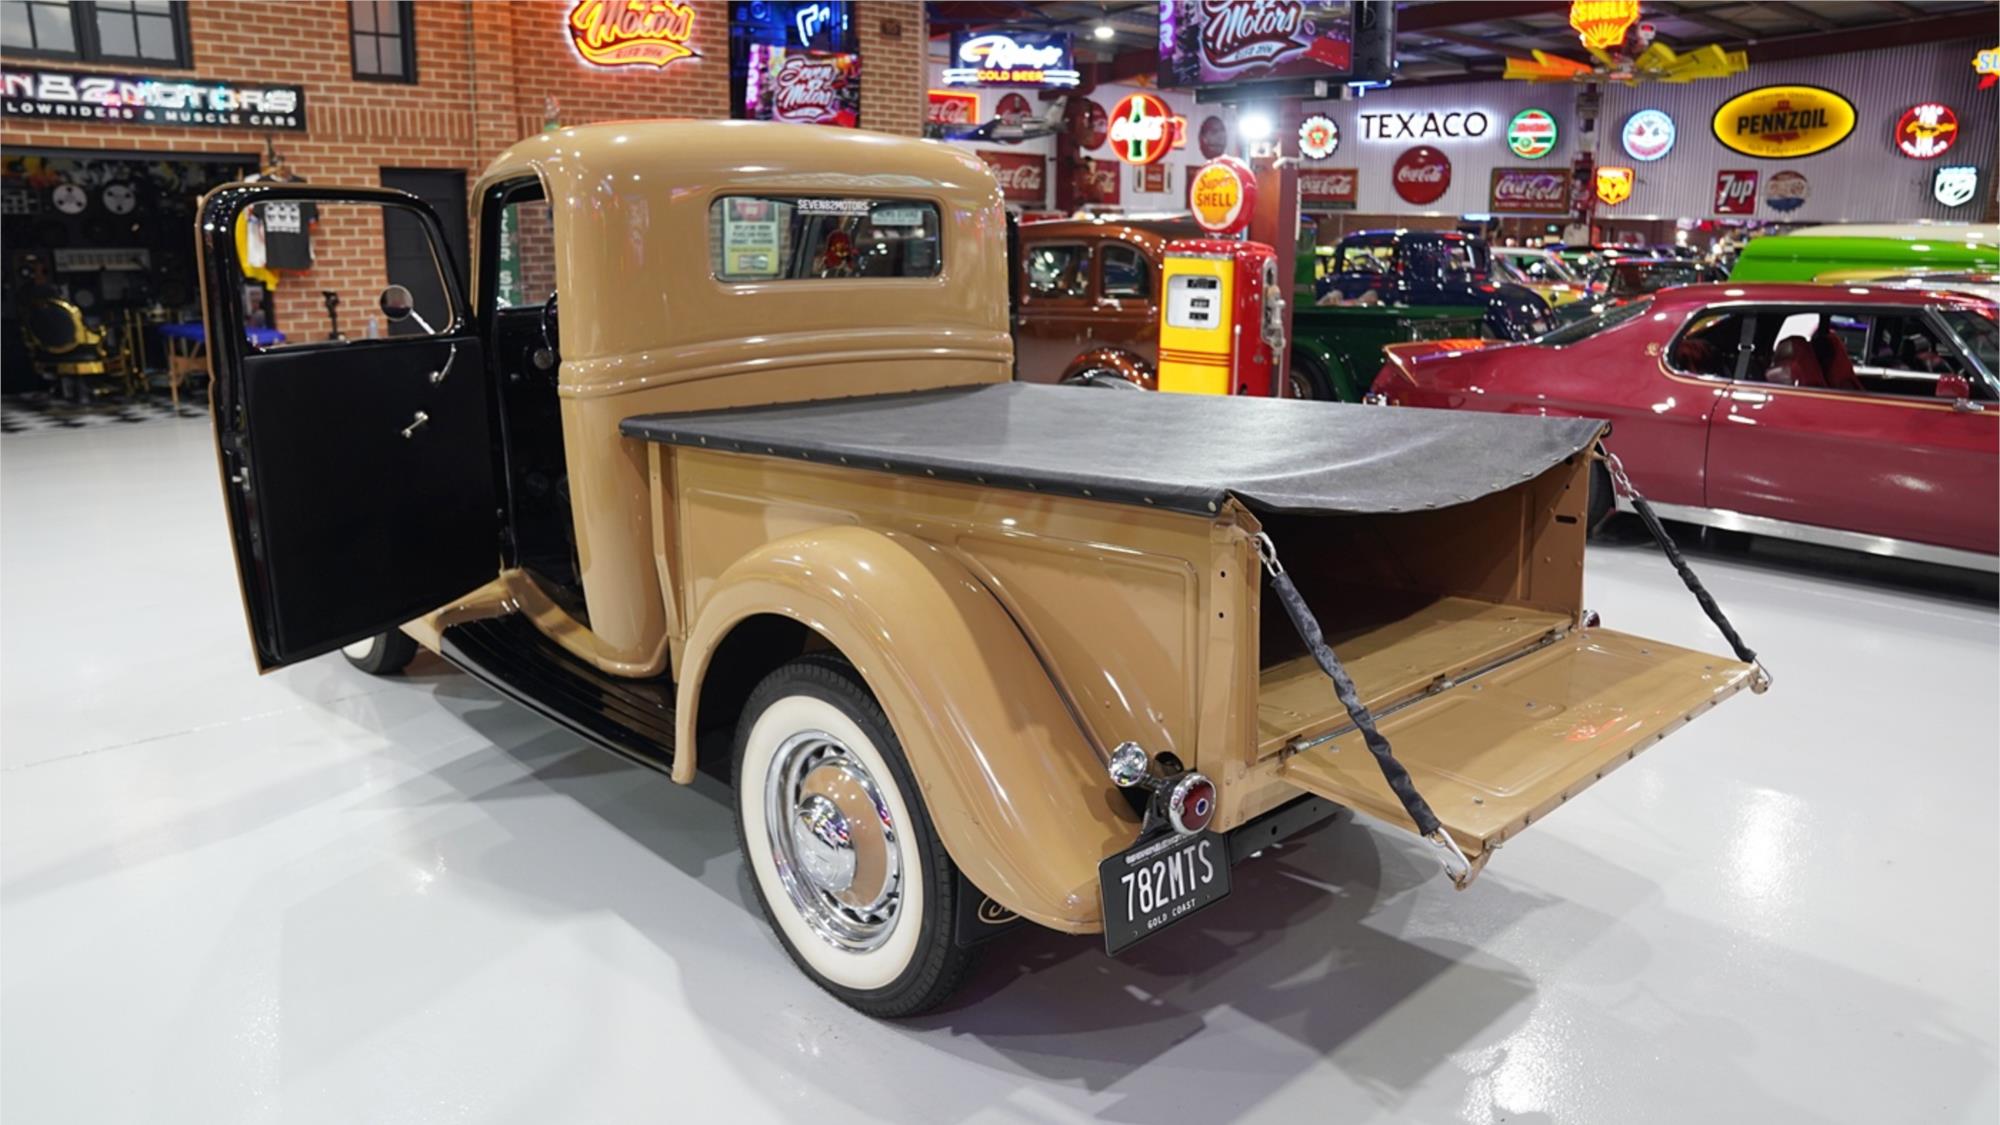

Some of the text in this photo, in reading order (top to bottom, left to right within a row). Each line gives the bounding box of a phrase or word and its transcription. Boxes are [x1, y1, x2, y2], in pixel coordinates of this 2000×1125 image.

[1206, 4, 1298, 50] Motors
[977, 71, 1045, 82] COLD BEER
[6, 101, 134, 119] LOWRIDERS
[164, 110, 241, 125] MUSCLE
[249, 114, 297, 127] CARS
[1360, 112, 1488, 140] TEXACO
[1736, 108, 1828, 136] PENNZOIL
[1196, 192, 1232, 207] SHELL
[1121, 840, 1213, 922] 782MTS
[1147, 899, 1195, 929] GOLD COAST
